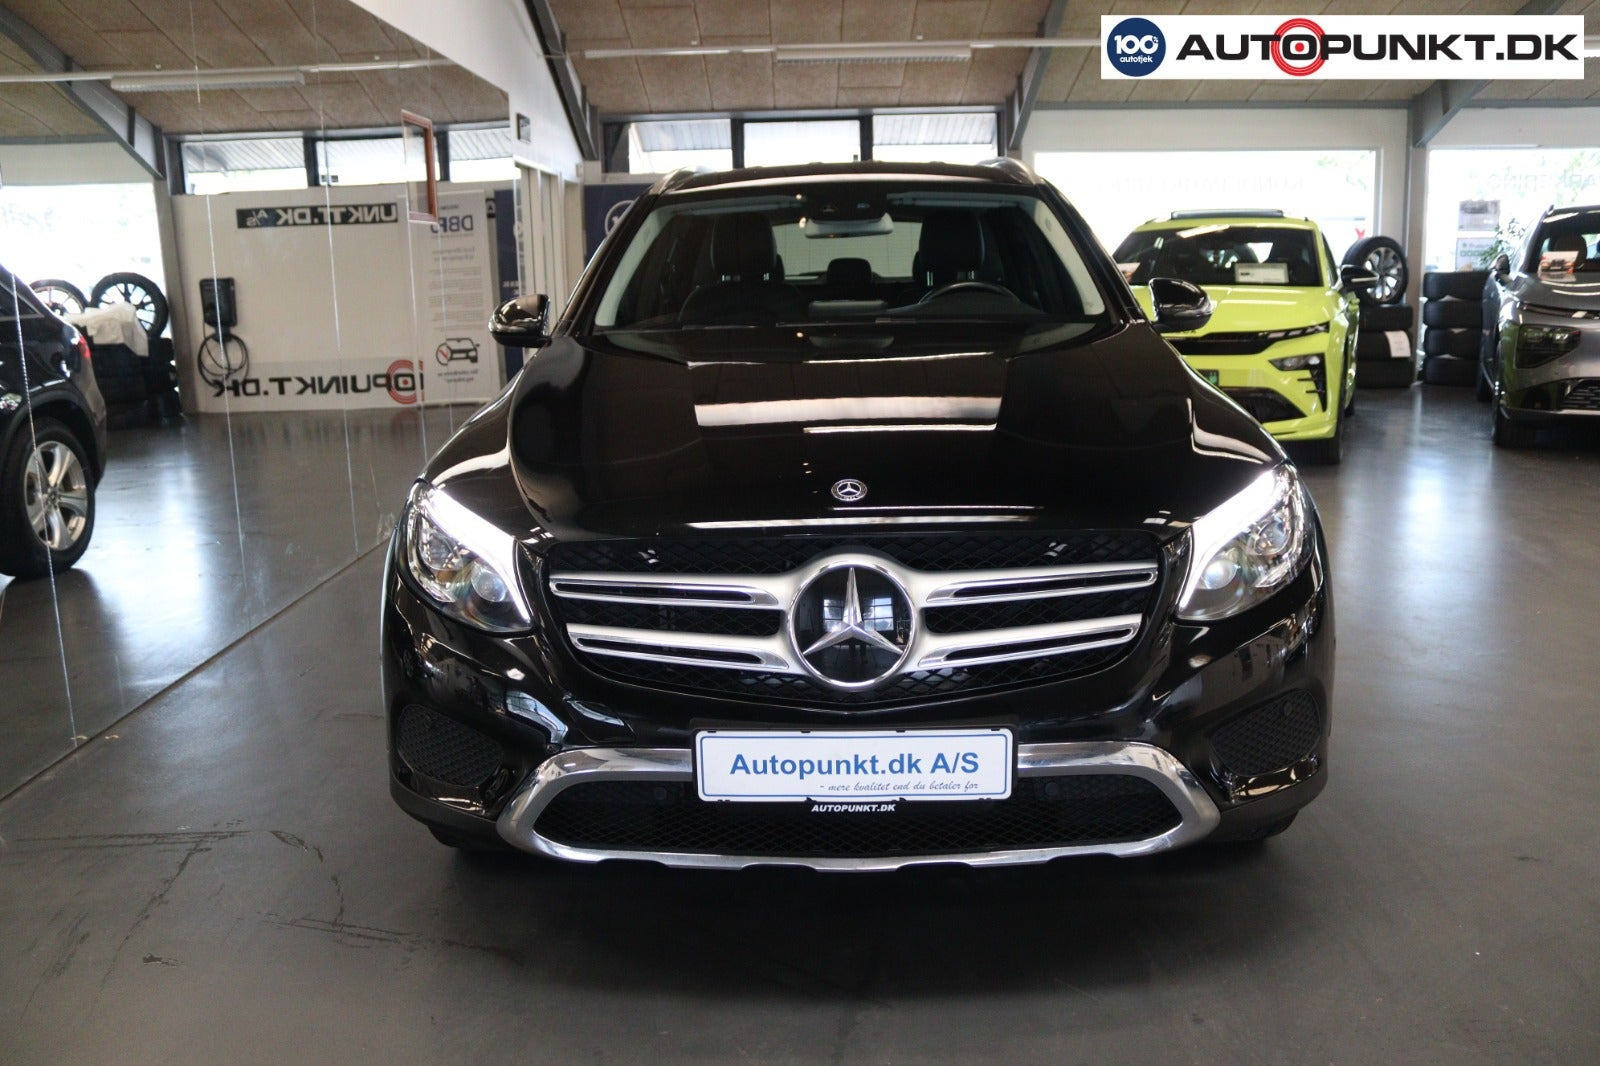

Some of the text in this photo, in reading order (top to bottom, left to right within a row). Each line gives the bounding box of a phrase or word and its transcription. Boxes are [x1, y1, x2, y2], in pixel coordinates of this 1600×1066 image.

[730, 752, 979, 779] Autopunkt.dk A/S
[828, 784, 850, 792] mere
[854, 781, 890, 792] kvalitet
[893, 781, 910, 791] end
[913, 781, 925, 790] du
[929, 780, 961, 790] betaler
[811, 804, 896, 812] AUTOPUNKT.DK
